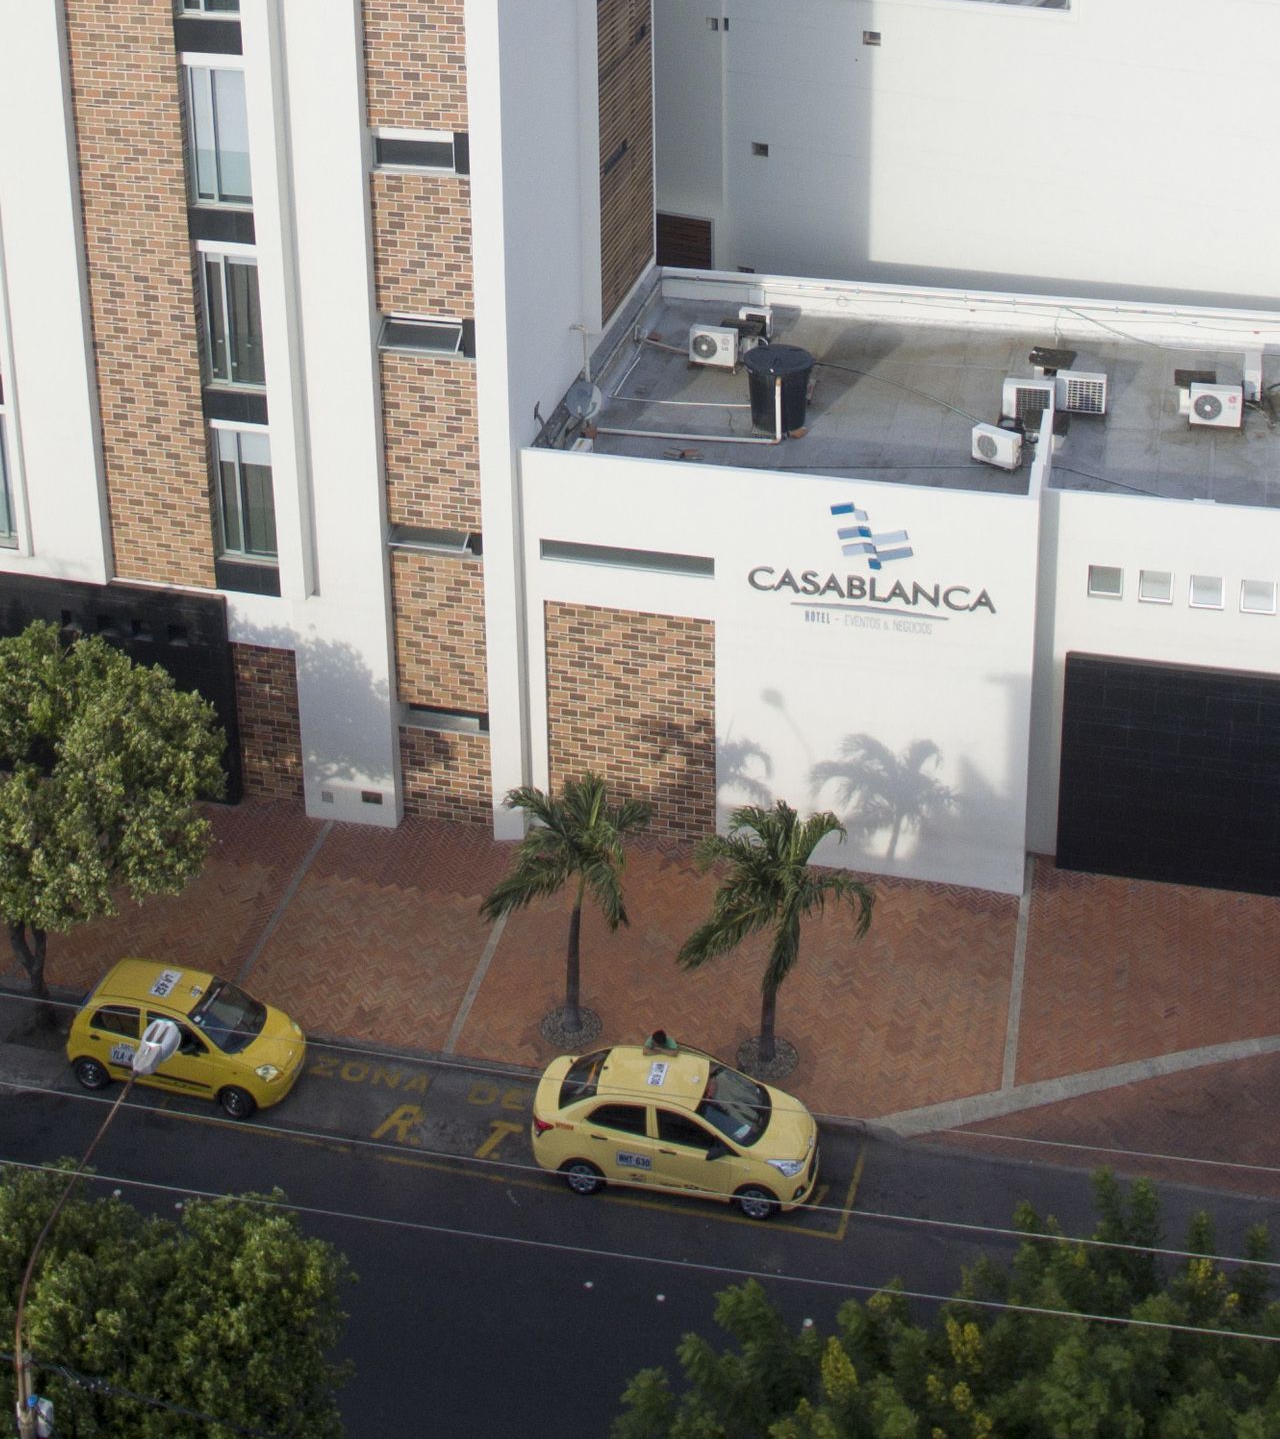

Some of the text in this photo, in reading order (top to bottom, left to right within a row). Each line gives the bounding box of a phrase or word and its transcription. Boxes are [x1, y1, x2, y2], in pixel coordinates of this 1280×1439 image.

[747, 565, 997, 614] CASABLANCA
[804, 610, 831, 625] HOTEL
[844, 614, 881, 631] EVENTOS
[893, 621, 933, 636] NEGOCIOS
[309, 1056, 532, 1110] ZONA DE
